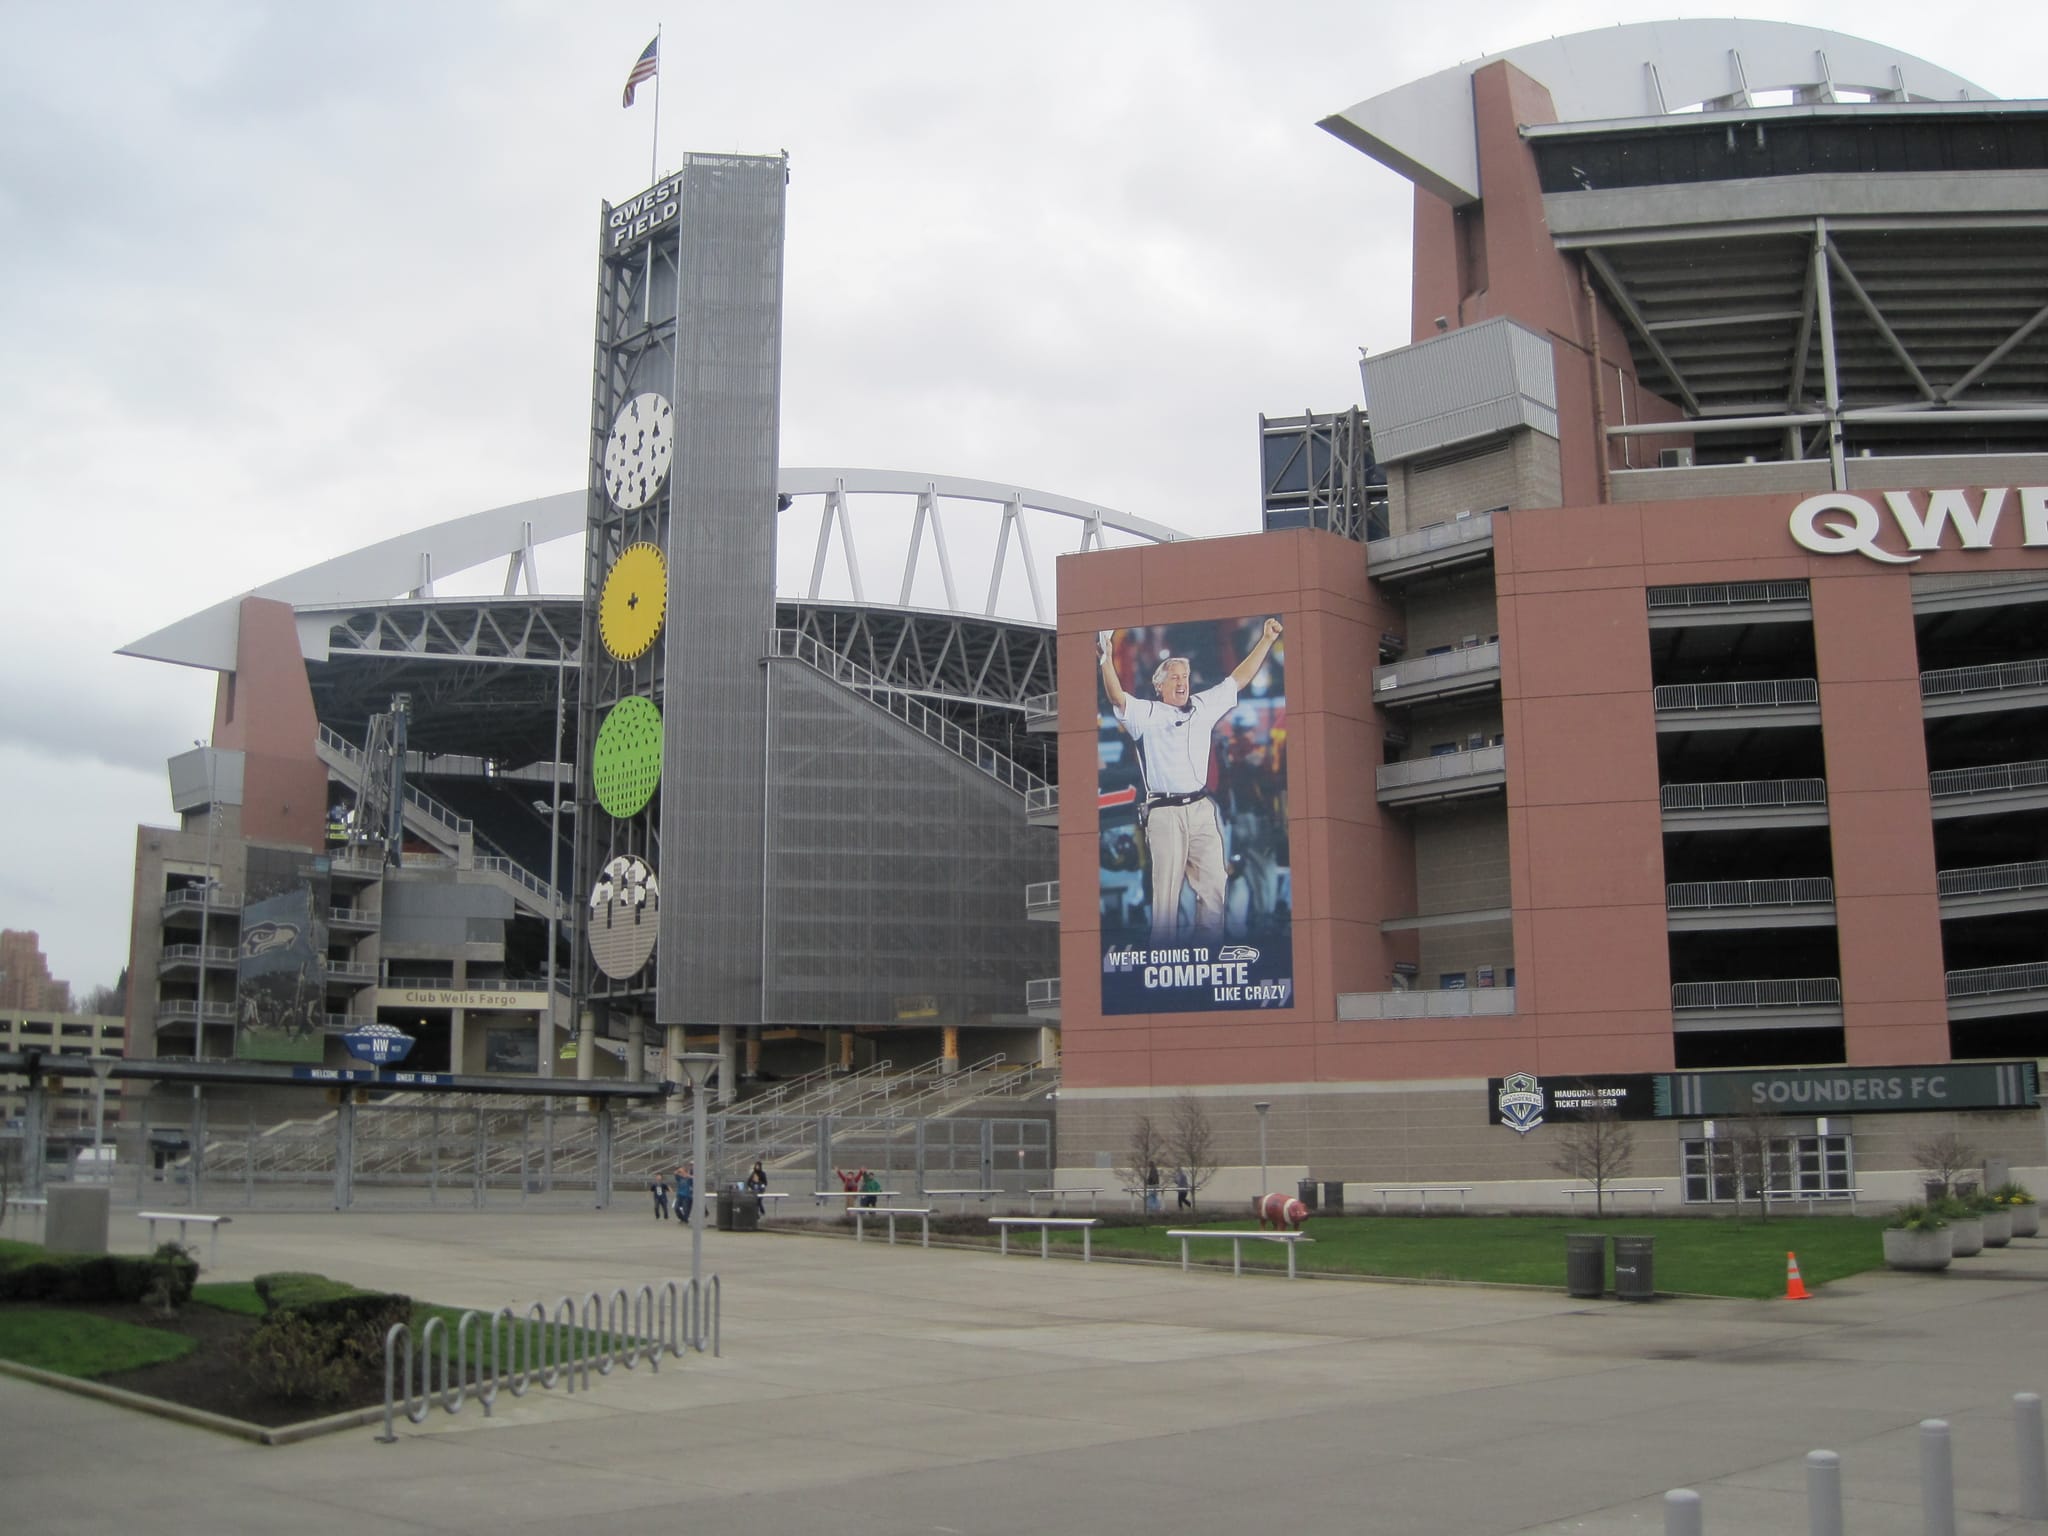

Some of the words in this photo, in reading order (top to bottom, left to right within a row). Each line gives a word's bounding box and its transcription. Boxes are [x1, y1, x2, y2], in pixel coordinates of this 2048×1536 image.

[609, 178, 682, 227] QWEST
[615, 202, 677, 247] FIELD
[1109, 950, 1147, 966] WE'RE
[1151, 949, 1190, 964] GOING
[1195, 947, 1209, 962] TO
[1144, 962, 1248, 988] COMPETE
[405, 991, 436, 1003] Club
[440, 992, 475, 1004] Wells
[479, 994, 517, 1007] Fargo
[1214, 987, 1241, 1002] LIKE
[1245, 985, 1286, 1001] CRAZY
[373, 1039, 389, 1052] NW
[311, 1069, 339, 1079] WELCOME
[421, 1073, 437, 1083] FIELD
[1554, 1089, 1596, 1098] INAUGURAL
[1598, 1088, 1627, 1097] SEASON
[1752, 1077, 1901, 1104] SOUNDERS
[1910, 1076, 1947, 1099] FC
[1555, 1100, 1580, 1108] TICKET
